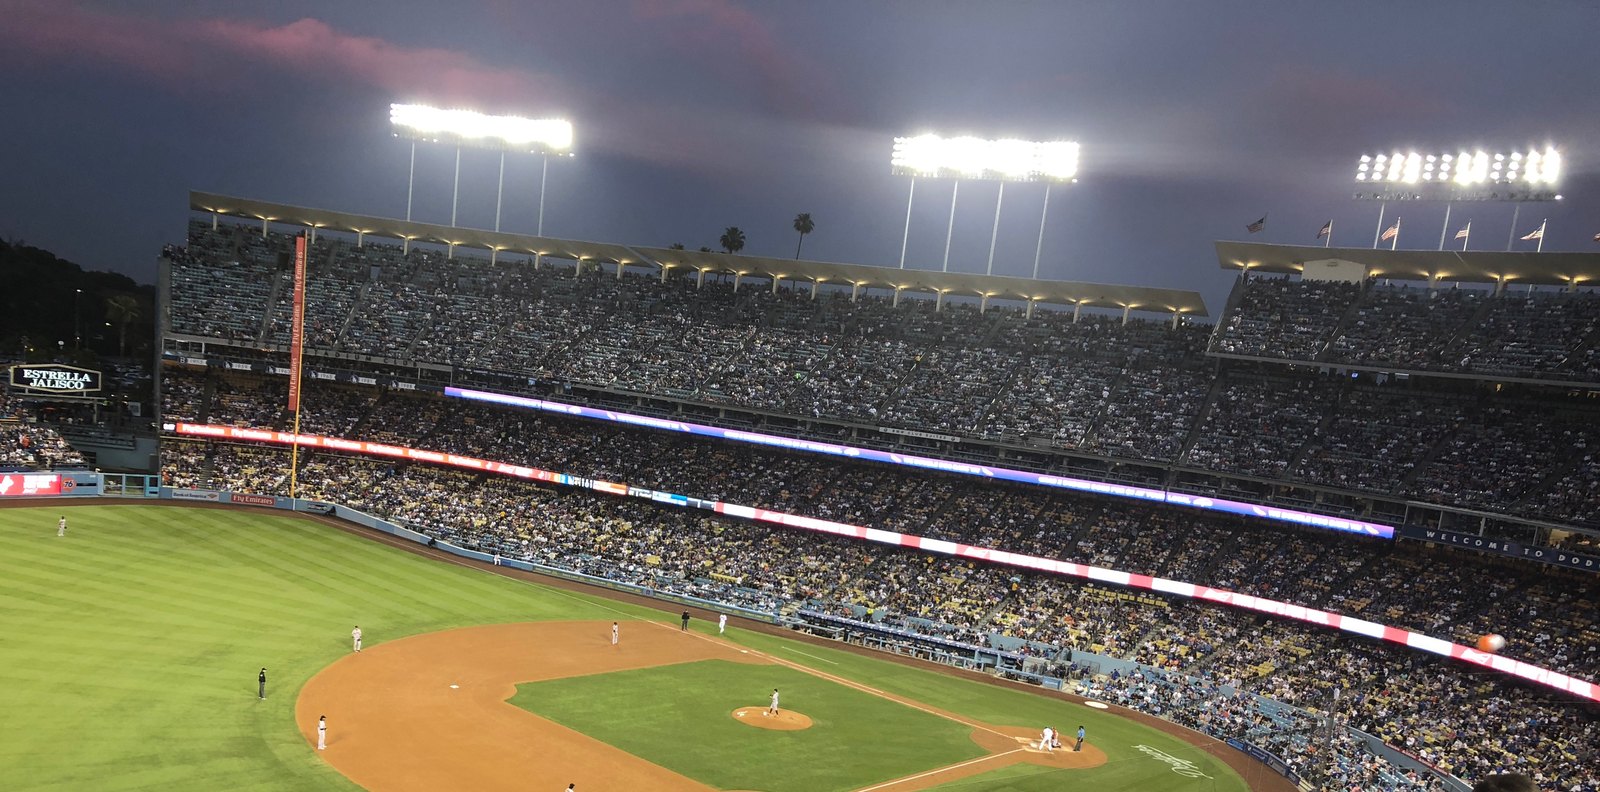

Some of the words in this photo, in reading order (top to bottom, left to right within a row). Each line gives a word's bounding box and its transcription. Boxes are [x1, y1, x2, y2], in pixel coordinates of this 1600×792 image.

[23, 369, 92, 382] ESTRELLA
[30, 379, 84, 389] JALISCO
[233, 495, 245, 503] Fly
[245, 495, 273, 505] Emirates
[1426, 530, 1509, 551] WELCOME
[1524, 548, 1543, 558] TO
[1558, 554, 1600, 567] DOD
